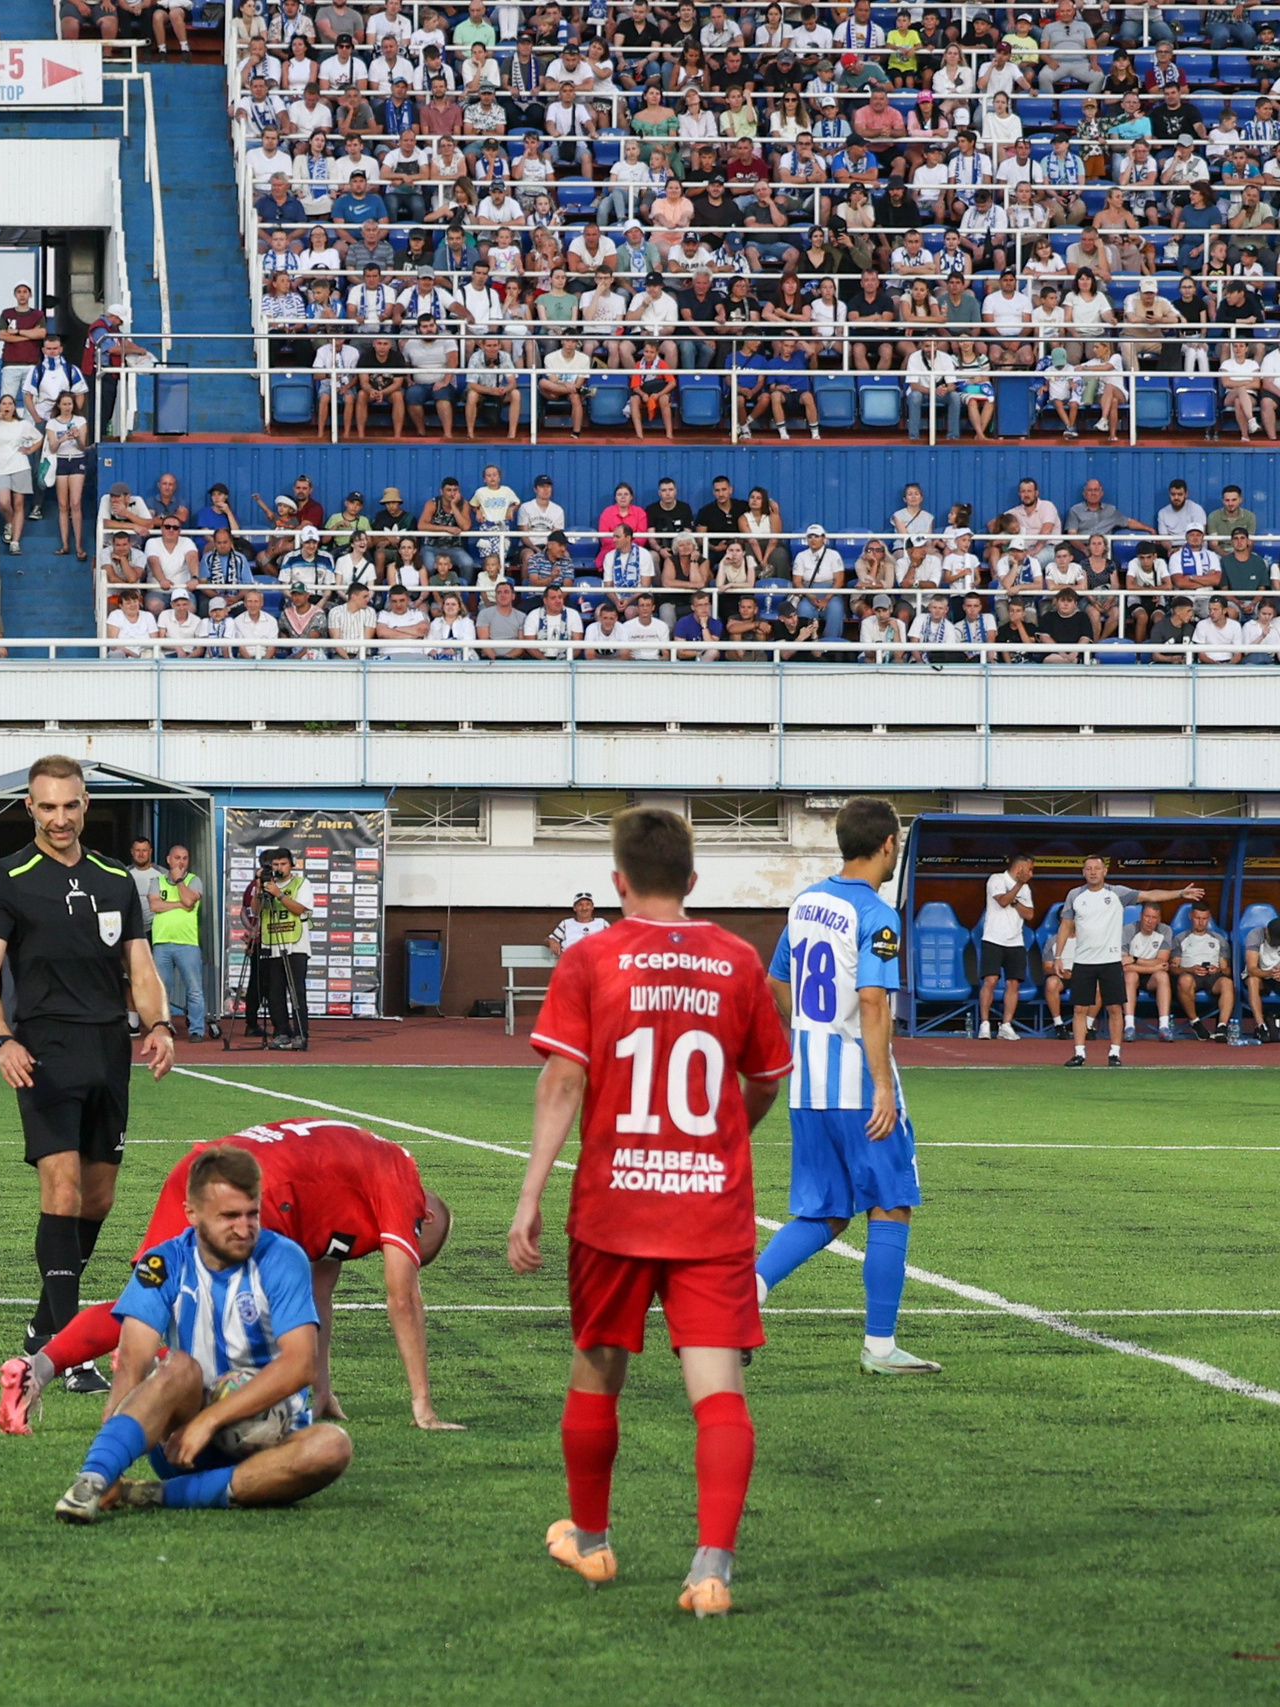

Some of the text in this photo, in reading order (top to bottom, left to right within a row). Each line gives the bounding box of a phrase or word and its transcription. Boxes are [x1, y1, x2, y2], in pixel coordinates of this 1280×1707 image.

[317, 820, 353, 830] ЛИГА
[634, 953, 733, 976] сервико
[792, 937, 837, 1023] 18
[630, 986, 719, 1017] ШИПУНОВ
[615, 1027, 725, 1137] 10
[613, 1148, 724, 1172] МЕДВЕДЬ
[610, 1170, 727, 1194] ХОЛДИНГ
